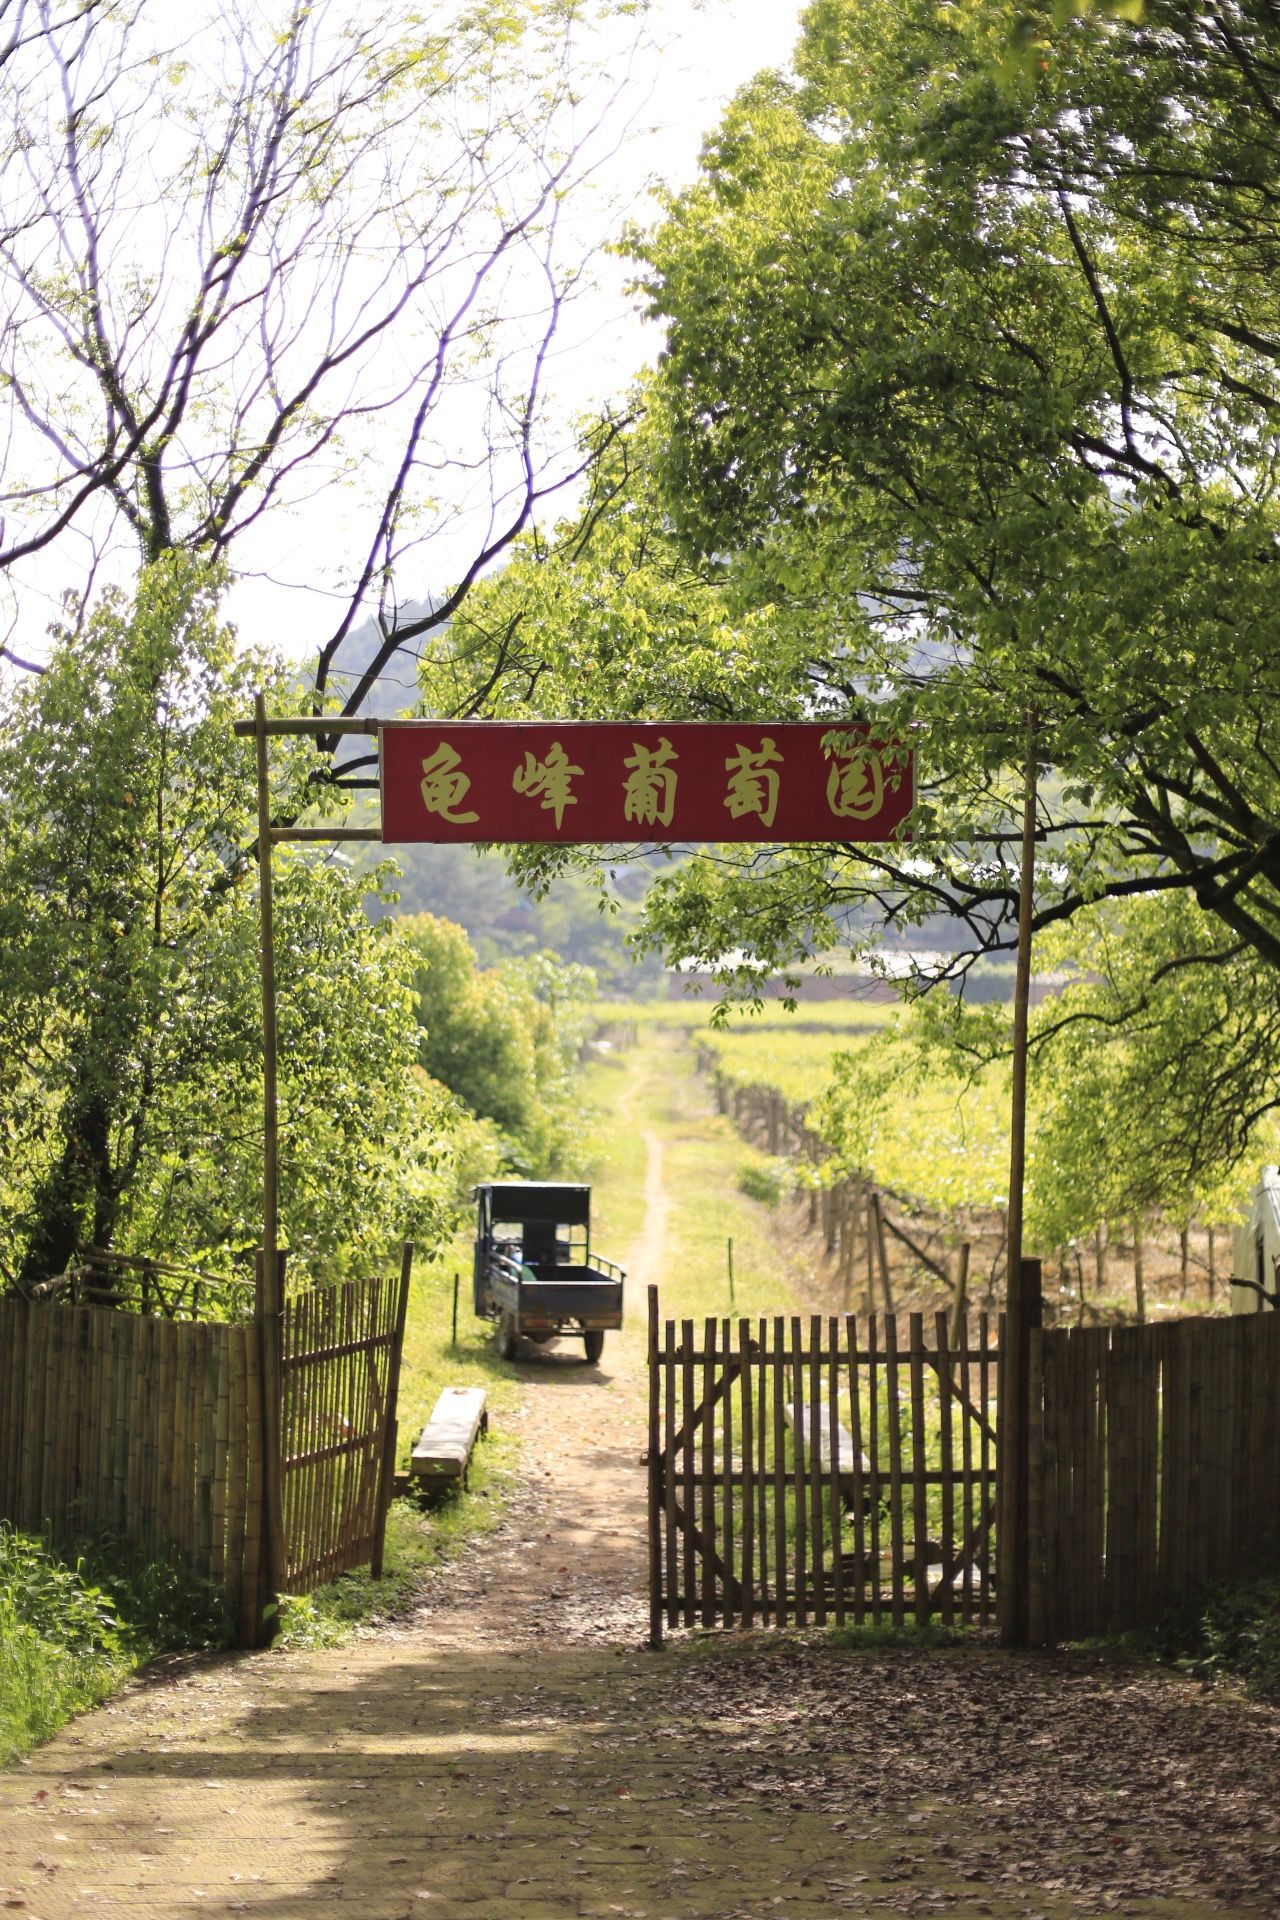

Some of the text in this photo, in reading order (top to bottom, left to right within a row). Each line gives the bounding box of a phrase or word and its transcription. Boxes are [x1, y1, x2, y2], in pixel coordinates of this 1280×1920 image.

[420, 737, 883, 829] 龟峰葡萄园
